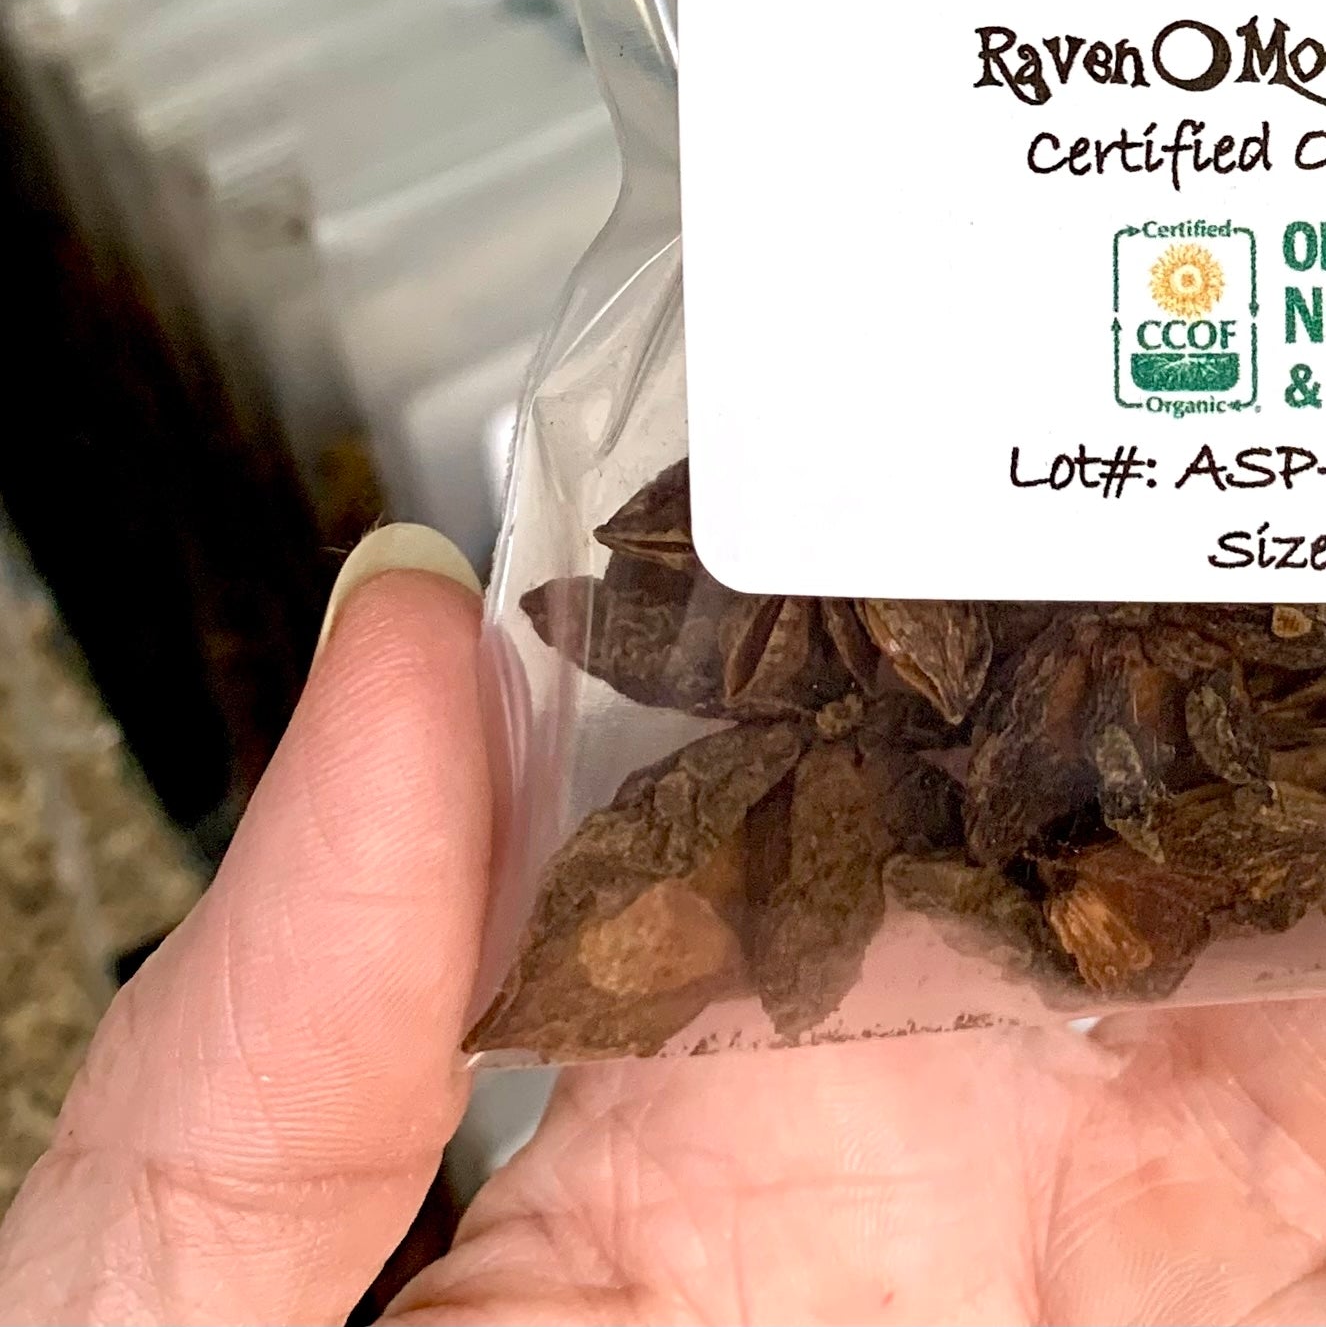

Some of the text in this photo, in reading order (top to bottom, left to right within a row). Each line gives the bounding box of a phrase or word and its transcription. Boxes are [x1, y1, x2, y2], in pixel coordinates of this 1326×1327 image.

[1026, 118, 1273, 192] Certified
[1141, 218, 1232, 239] Certified
[1136, 319, 1237, 352] CCOF
[1284, 363, 1323, 410] &
[1145, 396, 1232, 419] Organic
[1009, 443, 1158, 499] Lot#:
